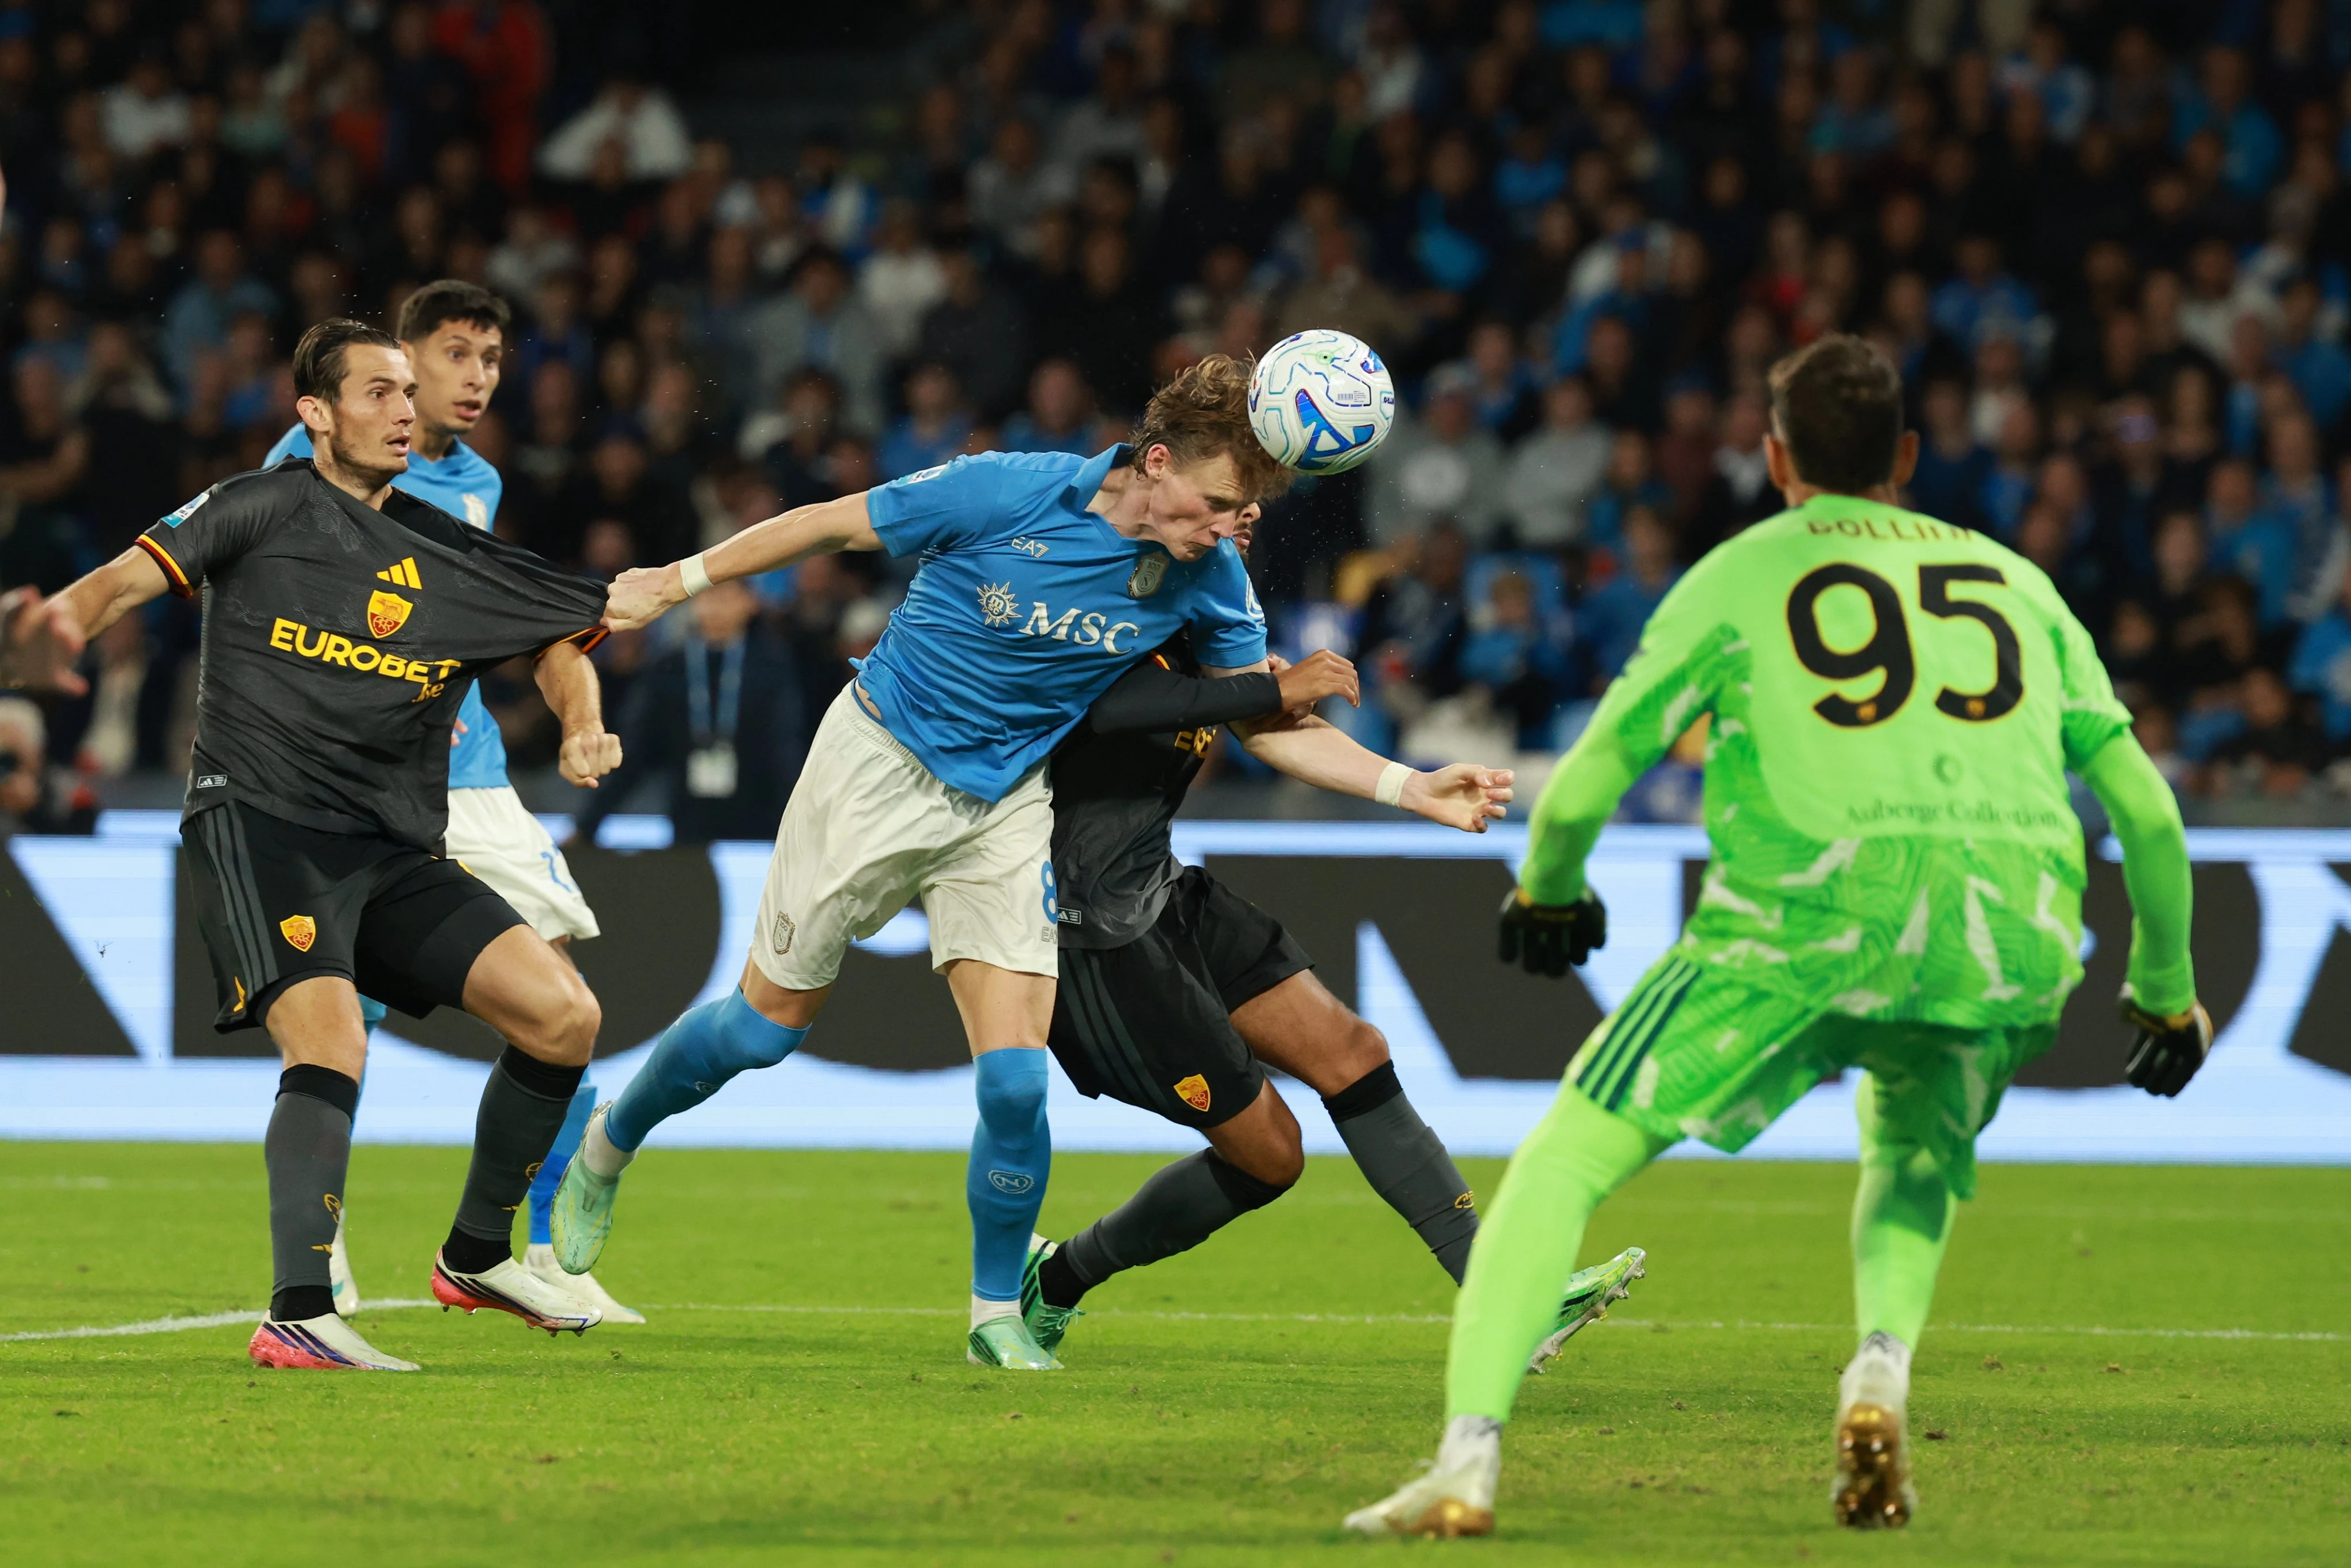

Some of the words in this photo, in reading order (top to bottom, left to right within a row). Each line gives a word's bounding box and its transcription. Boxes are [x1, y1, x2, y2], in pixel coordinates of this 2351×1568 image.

[1011, 536, 1049, 558] EA7
[269, 617, 461, 684] EUROBET
[1018, 601, 1141, 655] MSC
[1786, 561, 2024, 729] 95
[1041, 860, 1058, 925] 8
